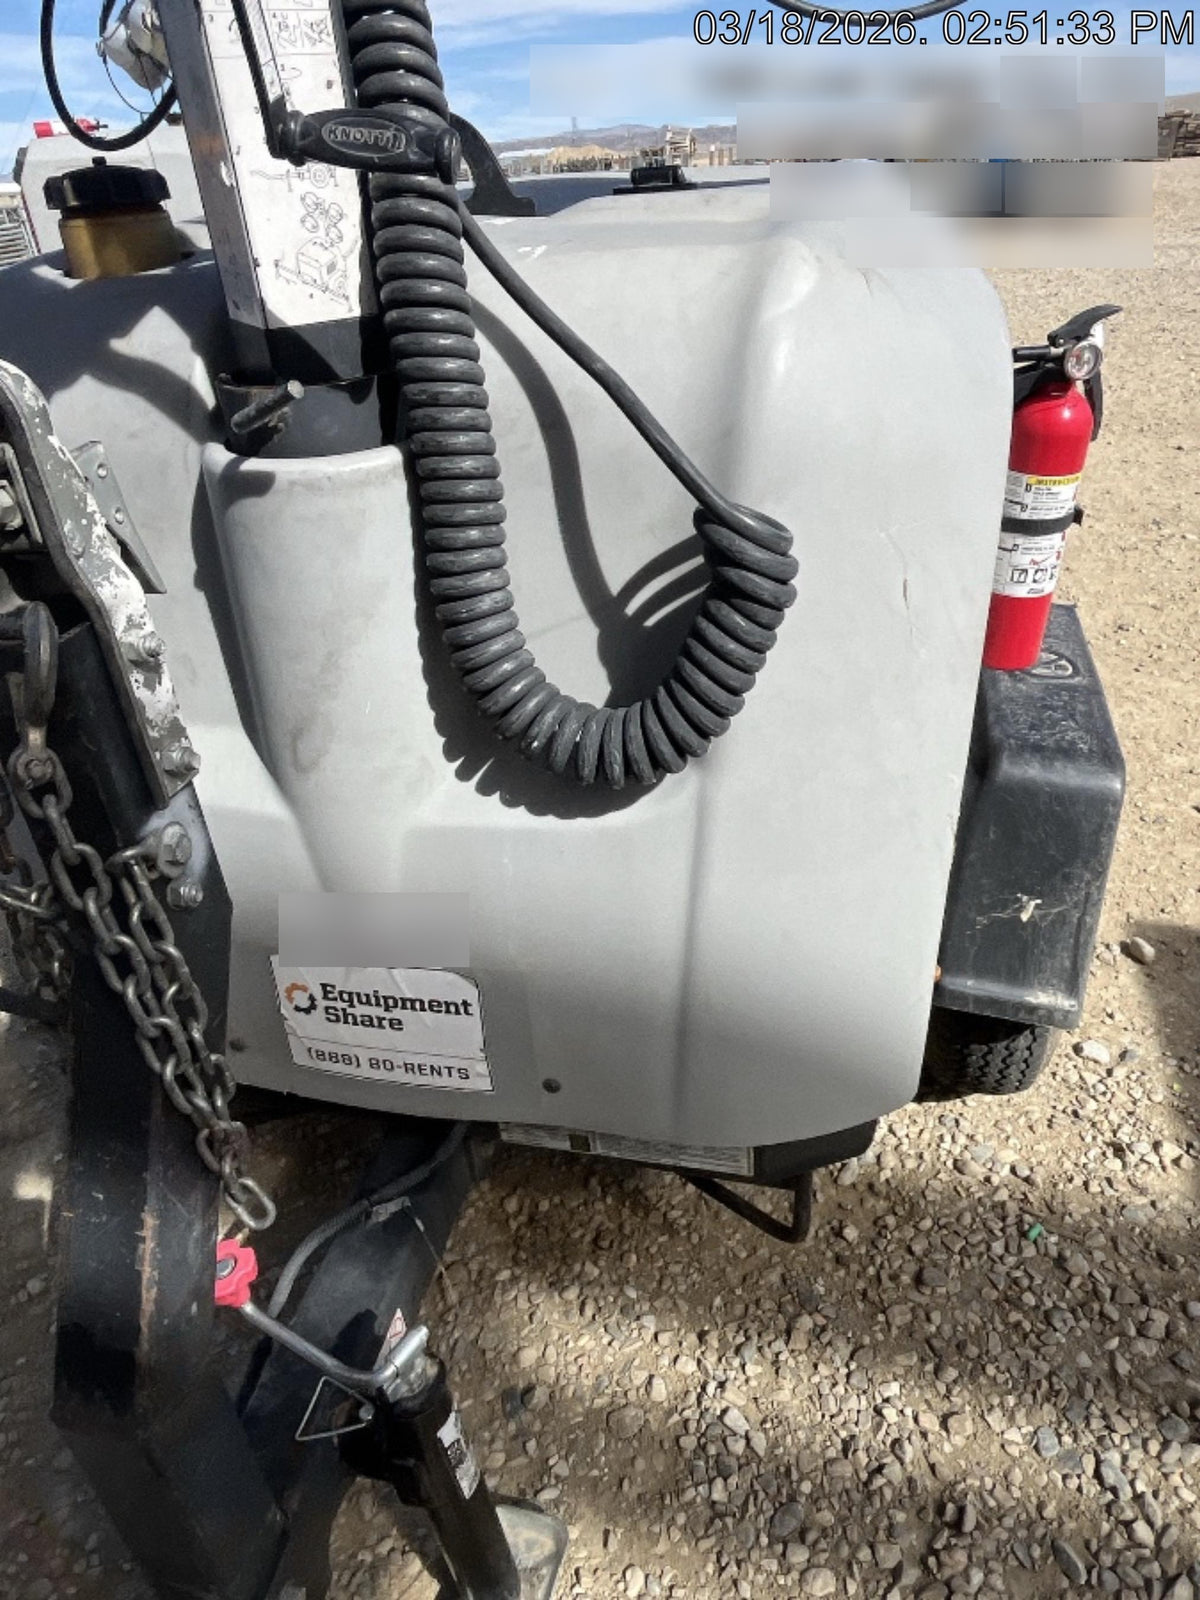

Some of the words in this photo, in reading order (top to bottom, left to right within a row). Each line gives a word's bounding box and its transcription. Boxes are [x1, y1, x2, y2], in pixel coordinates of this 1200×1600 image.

[319, 982, 474, 1017] Equipment
[324, 1005, 404, 1032] Share
[307, 1047, 361, 1068] (888)
[368, 1057, 470, 1081] 80-RENTS
